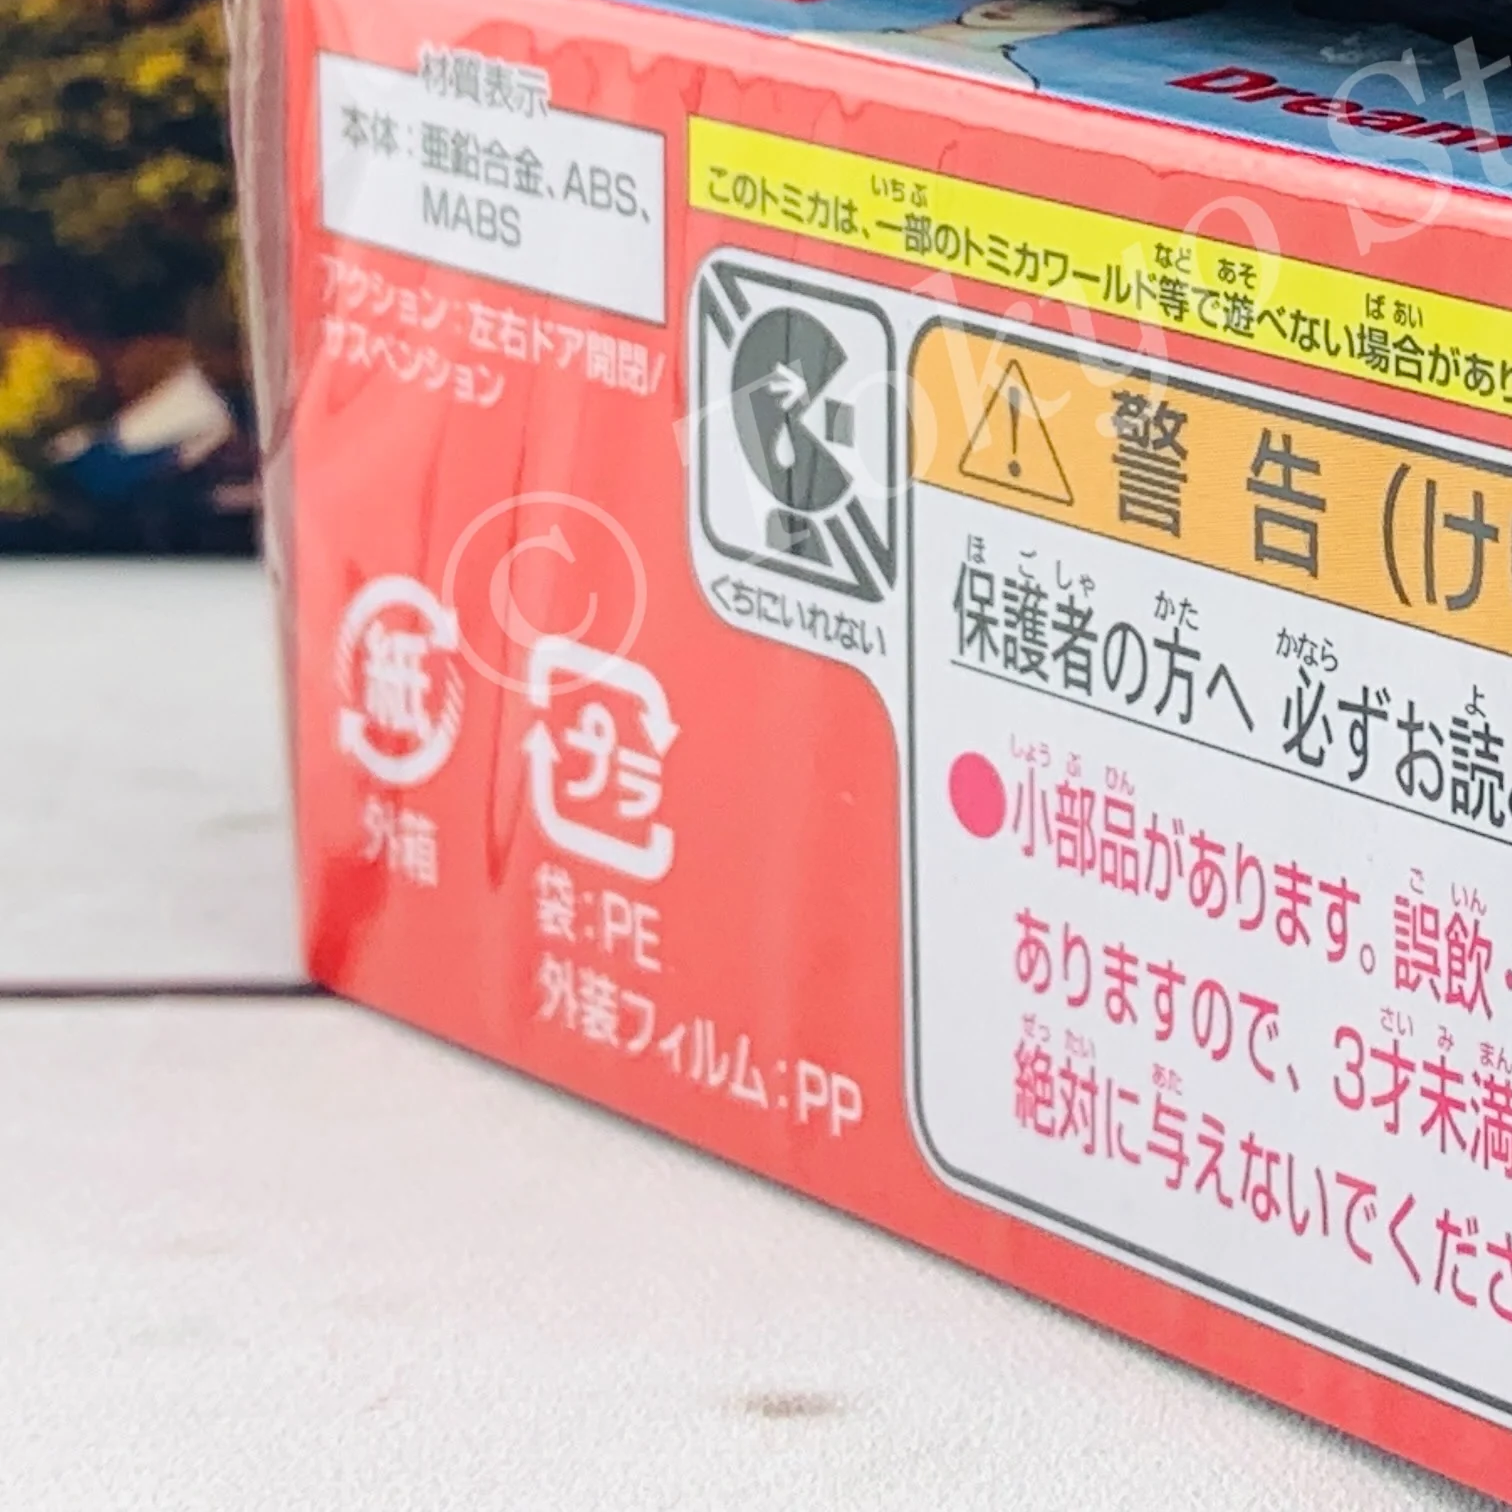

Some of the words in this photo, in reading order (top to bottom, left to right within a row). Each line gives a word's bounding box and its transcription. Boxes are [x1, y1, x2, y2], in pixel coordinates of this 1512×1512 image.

[420, 47, 550, 118] 材質表示
[422, 184, 522, 248] MABS
[321, 315, 505, 409] サスペンション
[710, 574, 887, 656] くちにいれない
[362, 620, 433, 737] 紙
